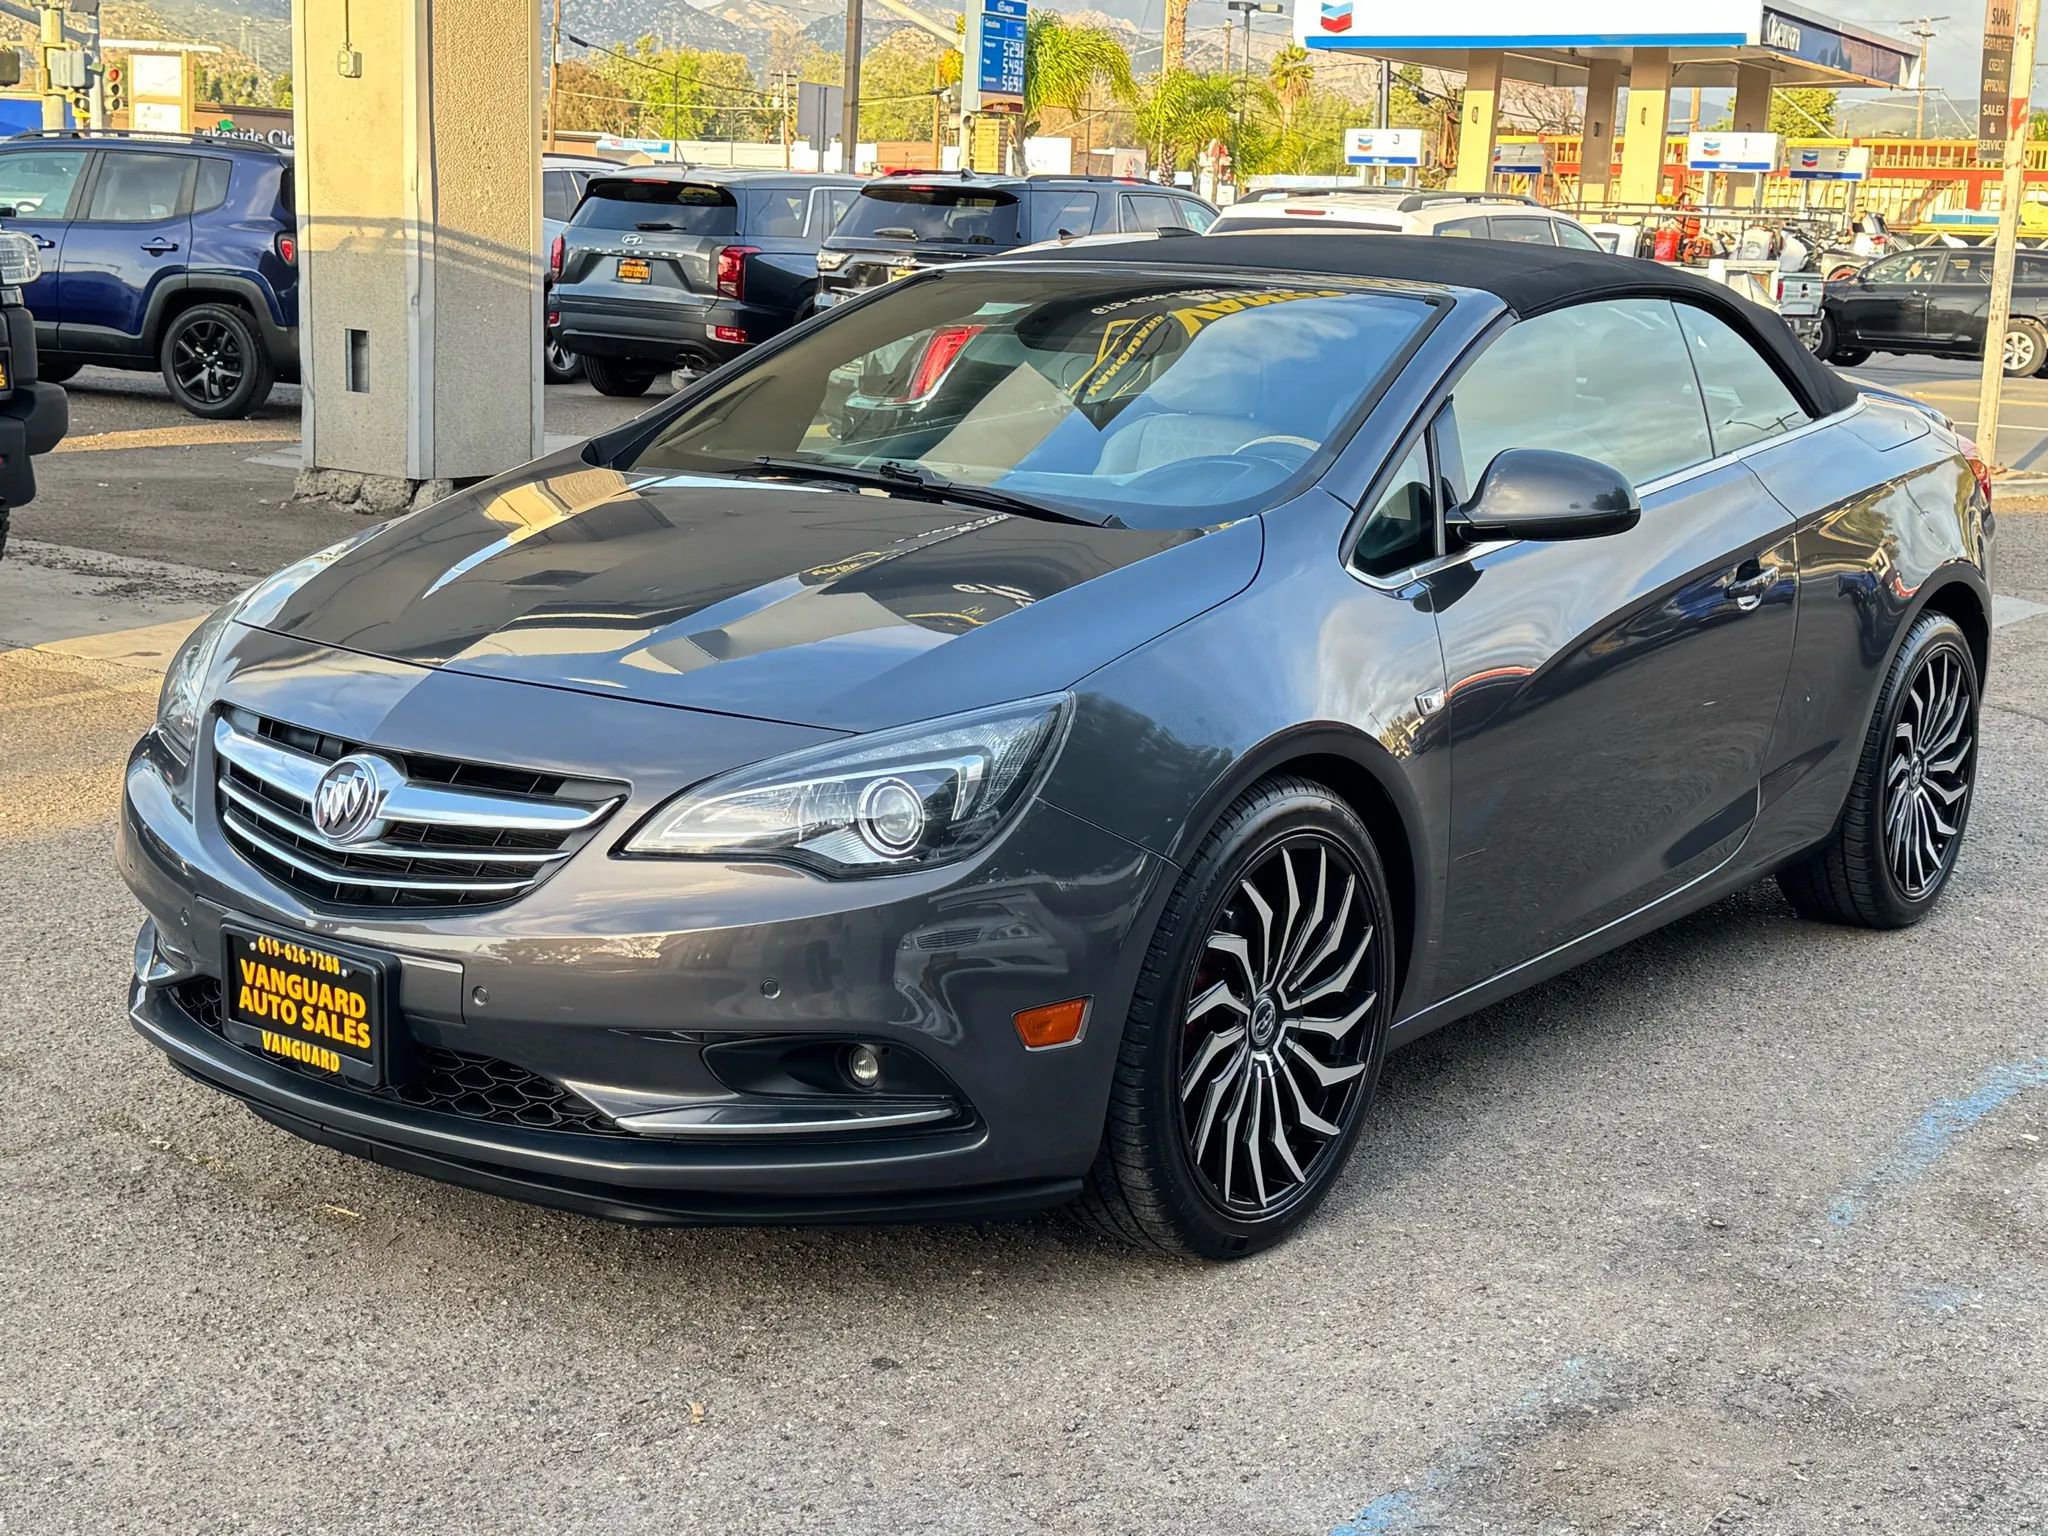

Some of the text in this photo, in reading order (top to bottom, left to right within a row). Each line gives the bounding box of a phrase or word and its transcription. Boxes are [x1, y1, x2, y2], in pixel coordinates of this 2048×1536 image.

[1991, 7, 2011, 27] SUVs
[1982, 104, 2006, 116] SALES
[1989, 122, 1996, 134] &
[1392, 133, 1400, 145] 3
[1519, 145, 1527, 156] 7
[1837, 150, 1847, 162] 5
[257, 935, 341, 976] 619-626-7288
[240, 958, 367, 1019] VANGUARD
[239, 985, 371, 1049] AUTO SALES
[261, 1029, 341, 1073] VANGUARD
